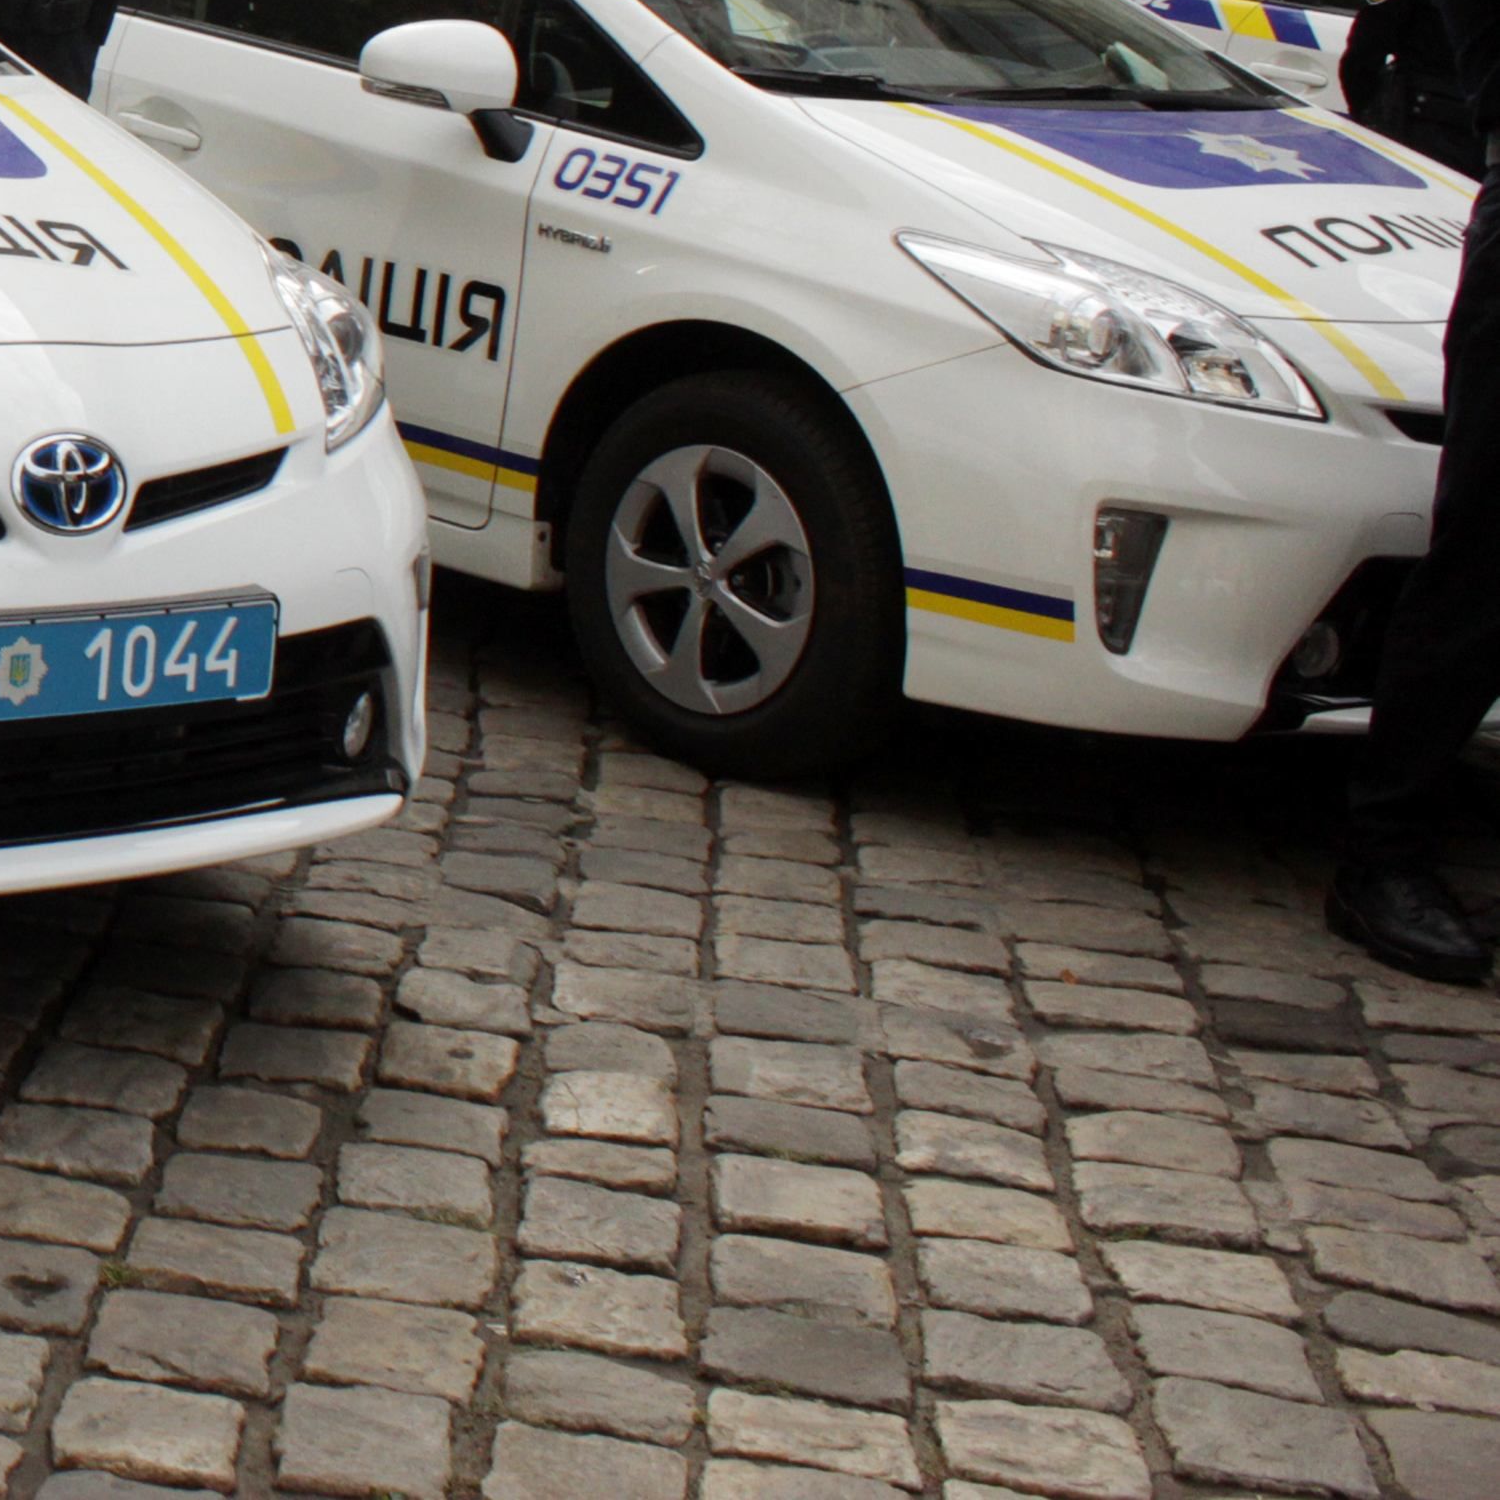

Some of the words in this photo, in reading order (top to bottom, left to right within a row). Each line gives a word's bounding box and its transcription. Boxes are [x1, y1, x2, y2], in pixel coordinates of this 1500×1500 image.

[553, 147, 680, 216] 0351
[1260, 214, 1467, 269] ПОЛІ
[83, 615, 241, 703] 1044
